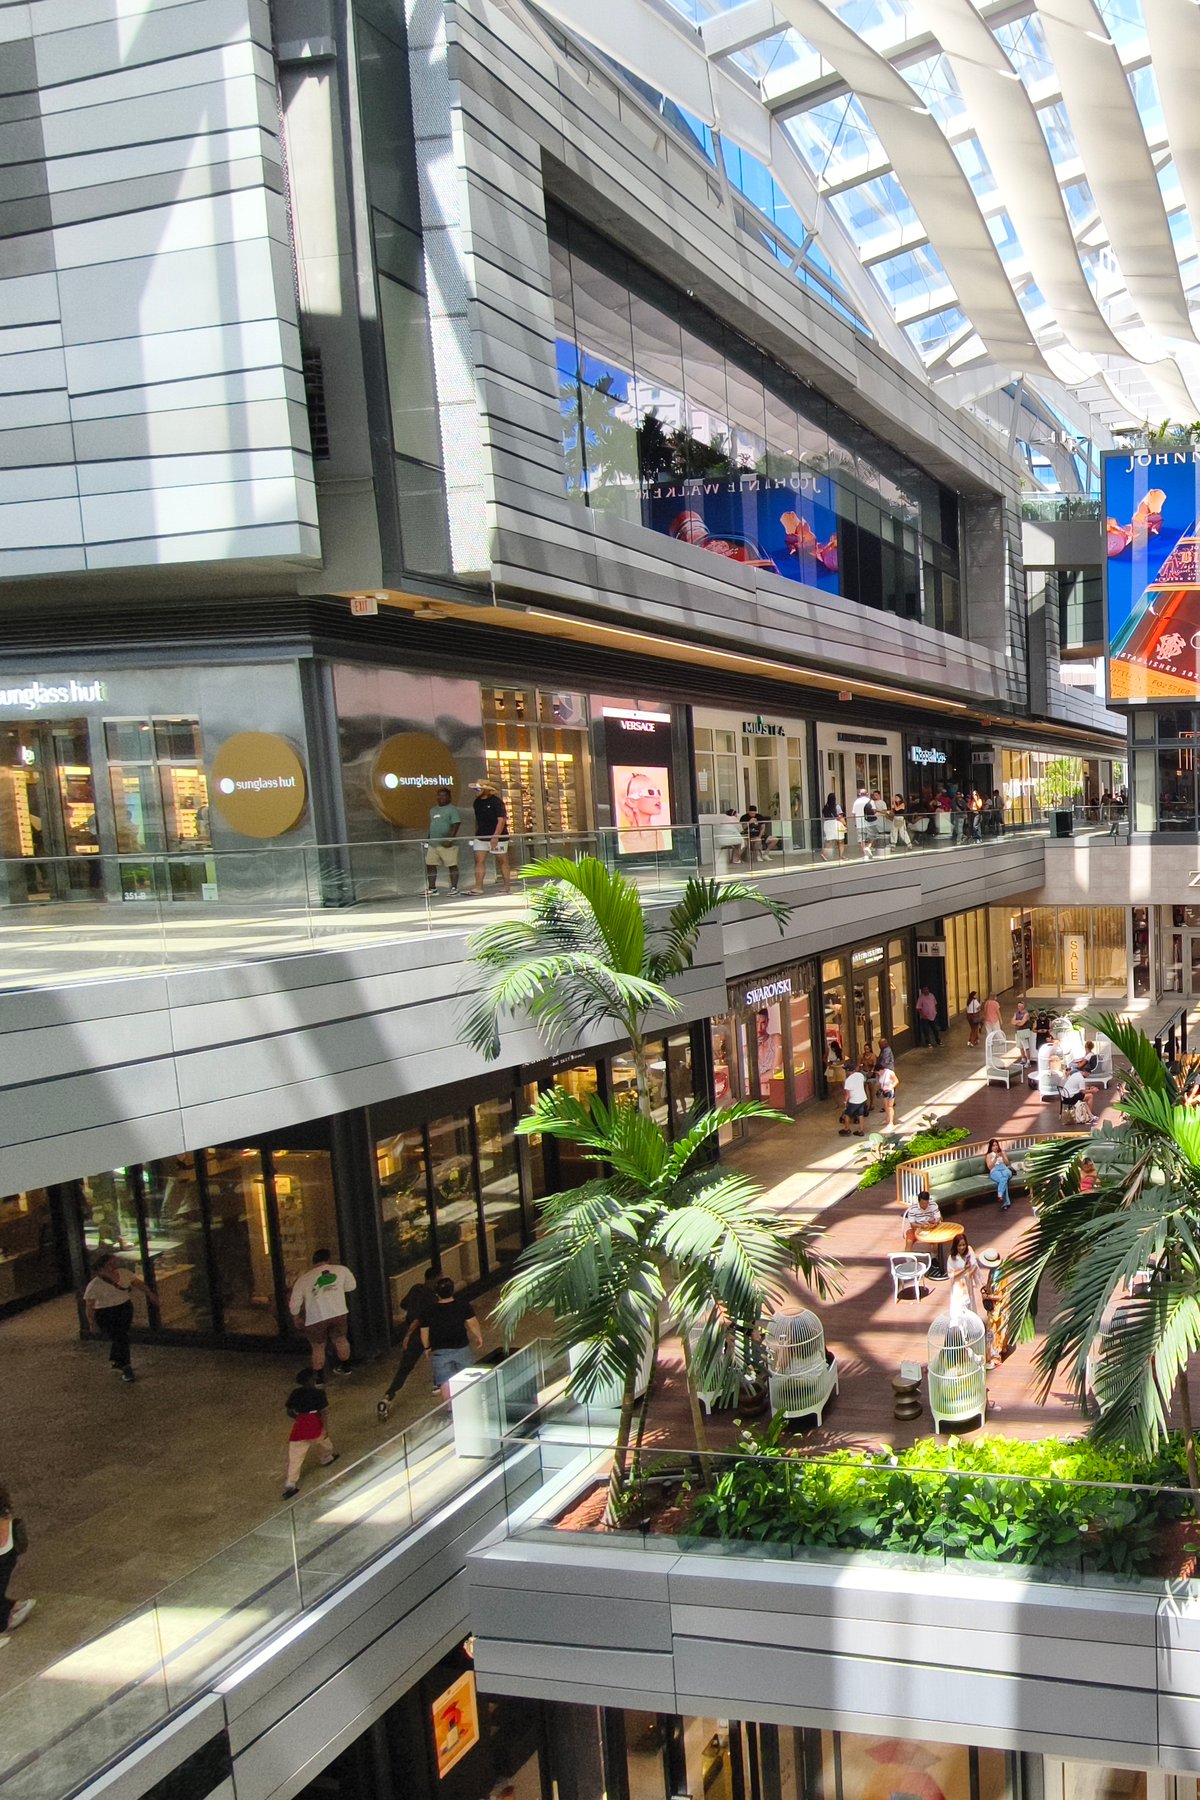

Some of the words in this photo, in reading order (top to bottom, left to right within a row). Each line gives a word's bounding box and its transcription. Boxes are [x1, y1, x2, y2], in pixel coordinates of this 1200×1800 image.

[0, 681, 68, 710] unglass
[69, 679, 105, 702] hut
[621, 720, 656, 732] VERSACE
[236, 777, 278, 792] sunglass
[278, 776, 296, 787] hut
[399, 774, 438, 788] sunglass
[438, 774, 454, 786] hut
[1070, 940, 1079, 981] SALE
[746, 978, 792, 1005] SWAROVSKI
